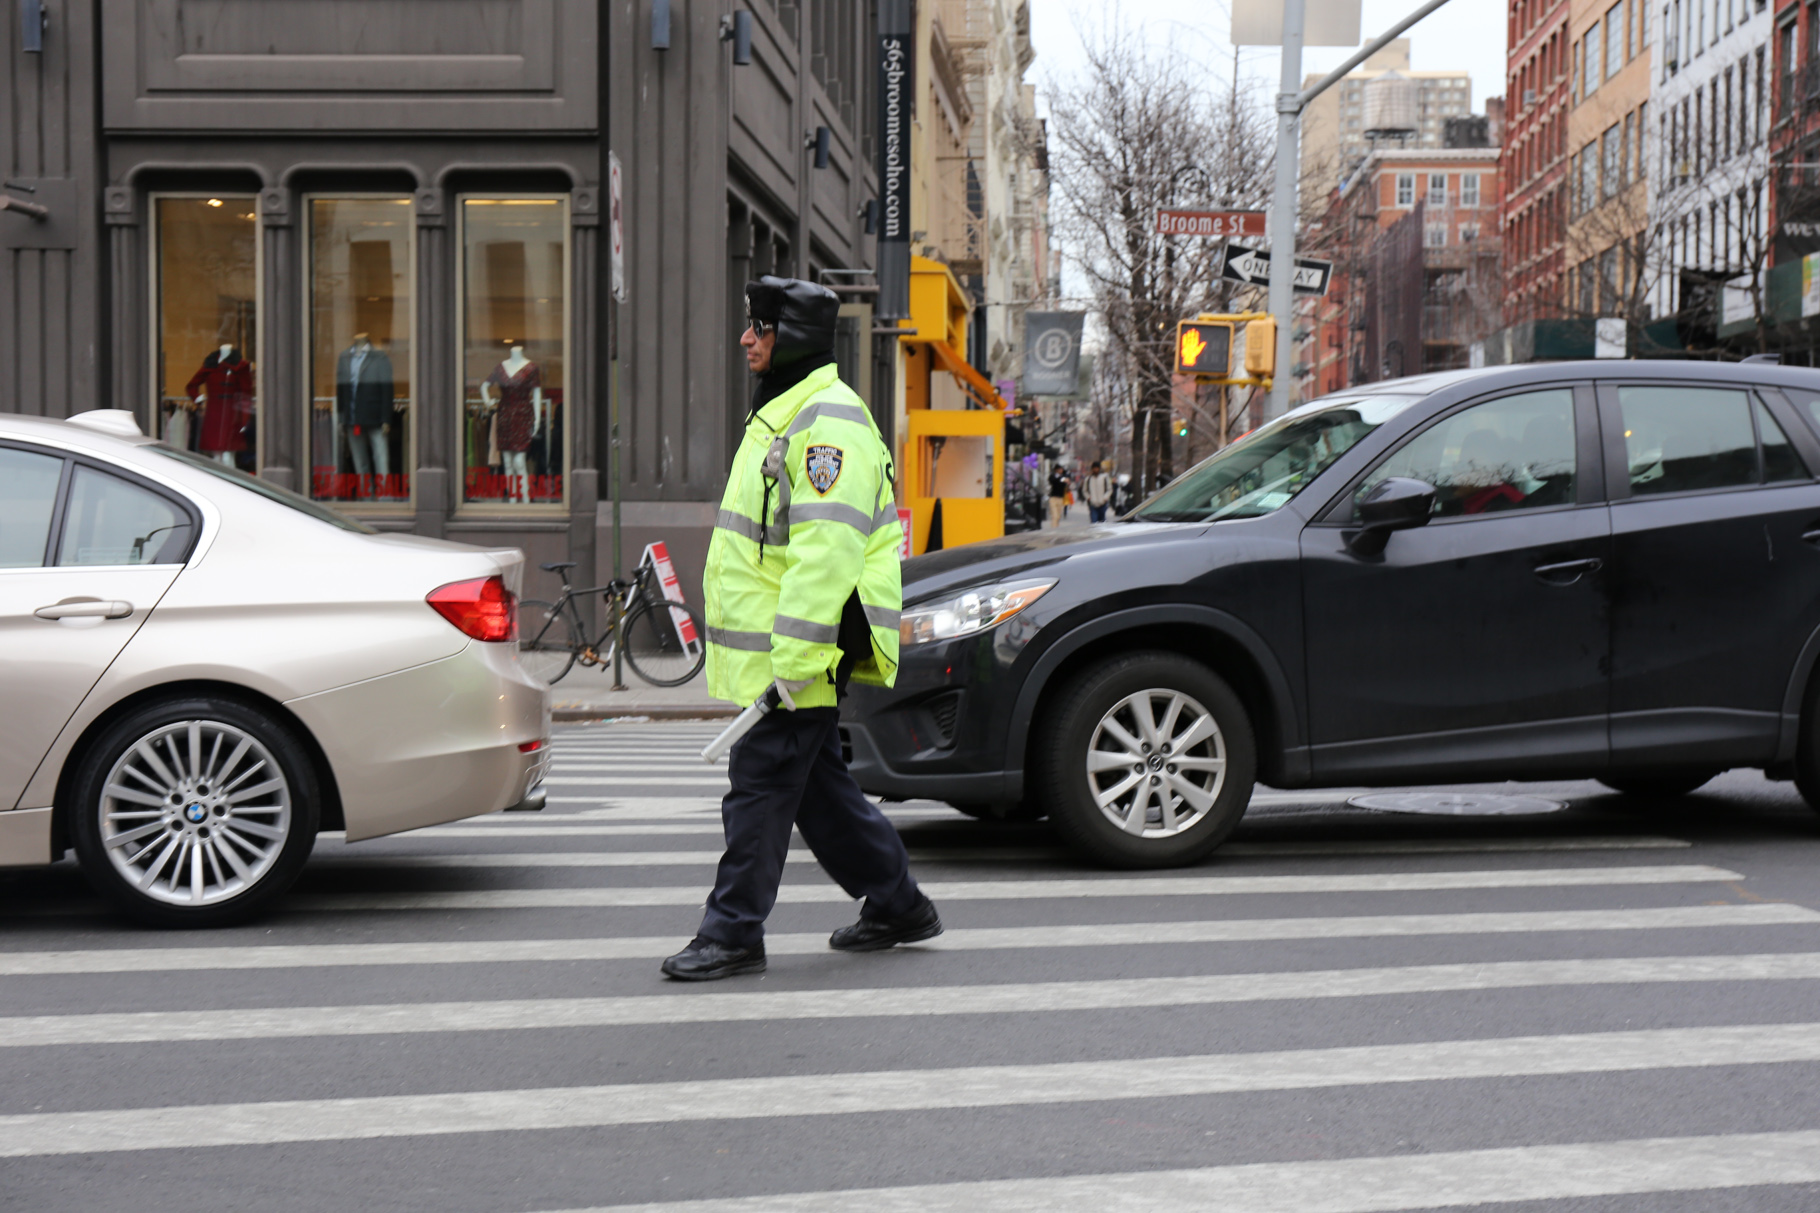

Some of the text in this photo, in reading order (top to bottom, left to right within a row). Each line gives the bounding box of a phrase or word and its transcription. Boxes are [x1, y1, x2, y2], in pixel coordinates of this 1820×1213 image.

[882, 39, 905, 237] 565broomesoho.com
[1159, 213, 1245, 233] Broome St
[813, 447, 837, 455] TRAFFIC
[313, 473, 410, 498] SAMPLE SALE
[465, 474, 563, 499] SAMPLE SALE
